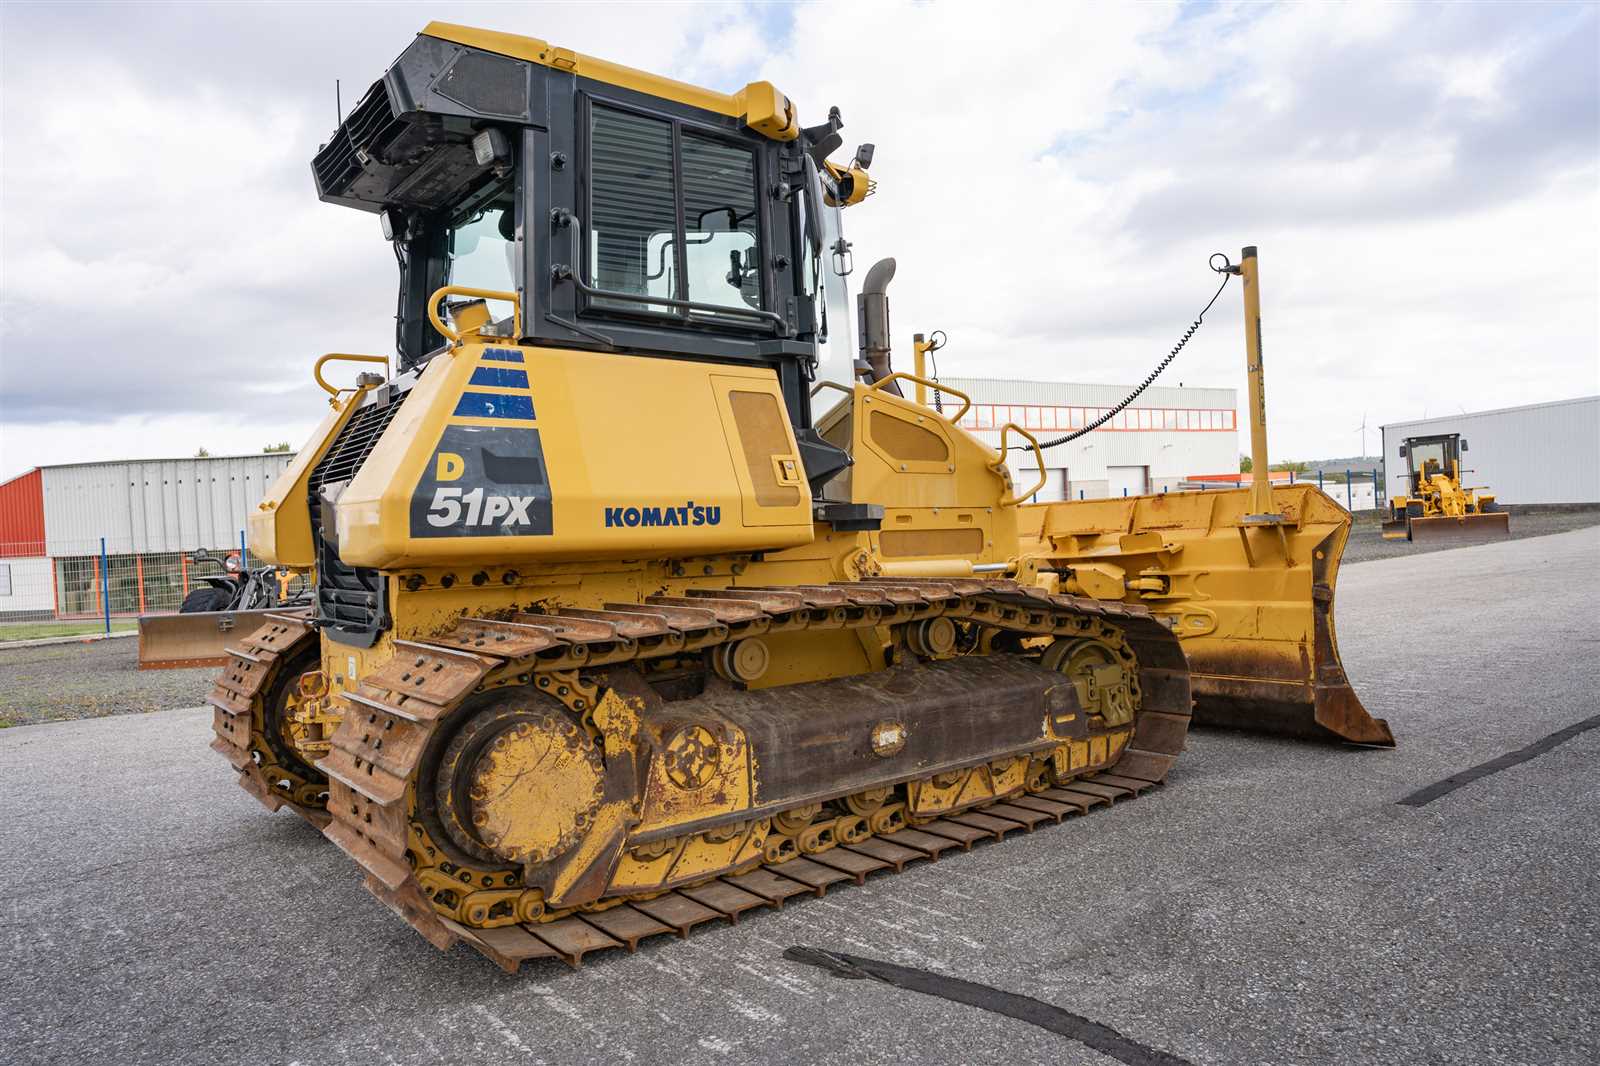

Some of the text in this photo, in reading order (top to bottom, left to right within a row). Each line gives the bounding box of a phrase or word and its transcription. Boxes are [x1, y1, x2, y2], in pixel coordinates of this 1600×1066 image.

[435, 452, 465, 482] D
[427, 487, 535, 527] 51PX
[605, 501, 721, 527] KOMATSU
